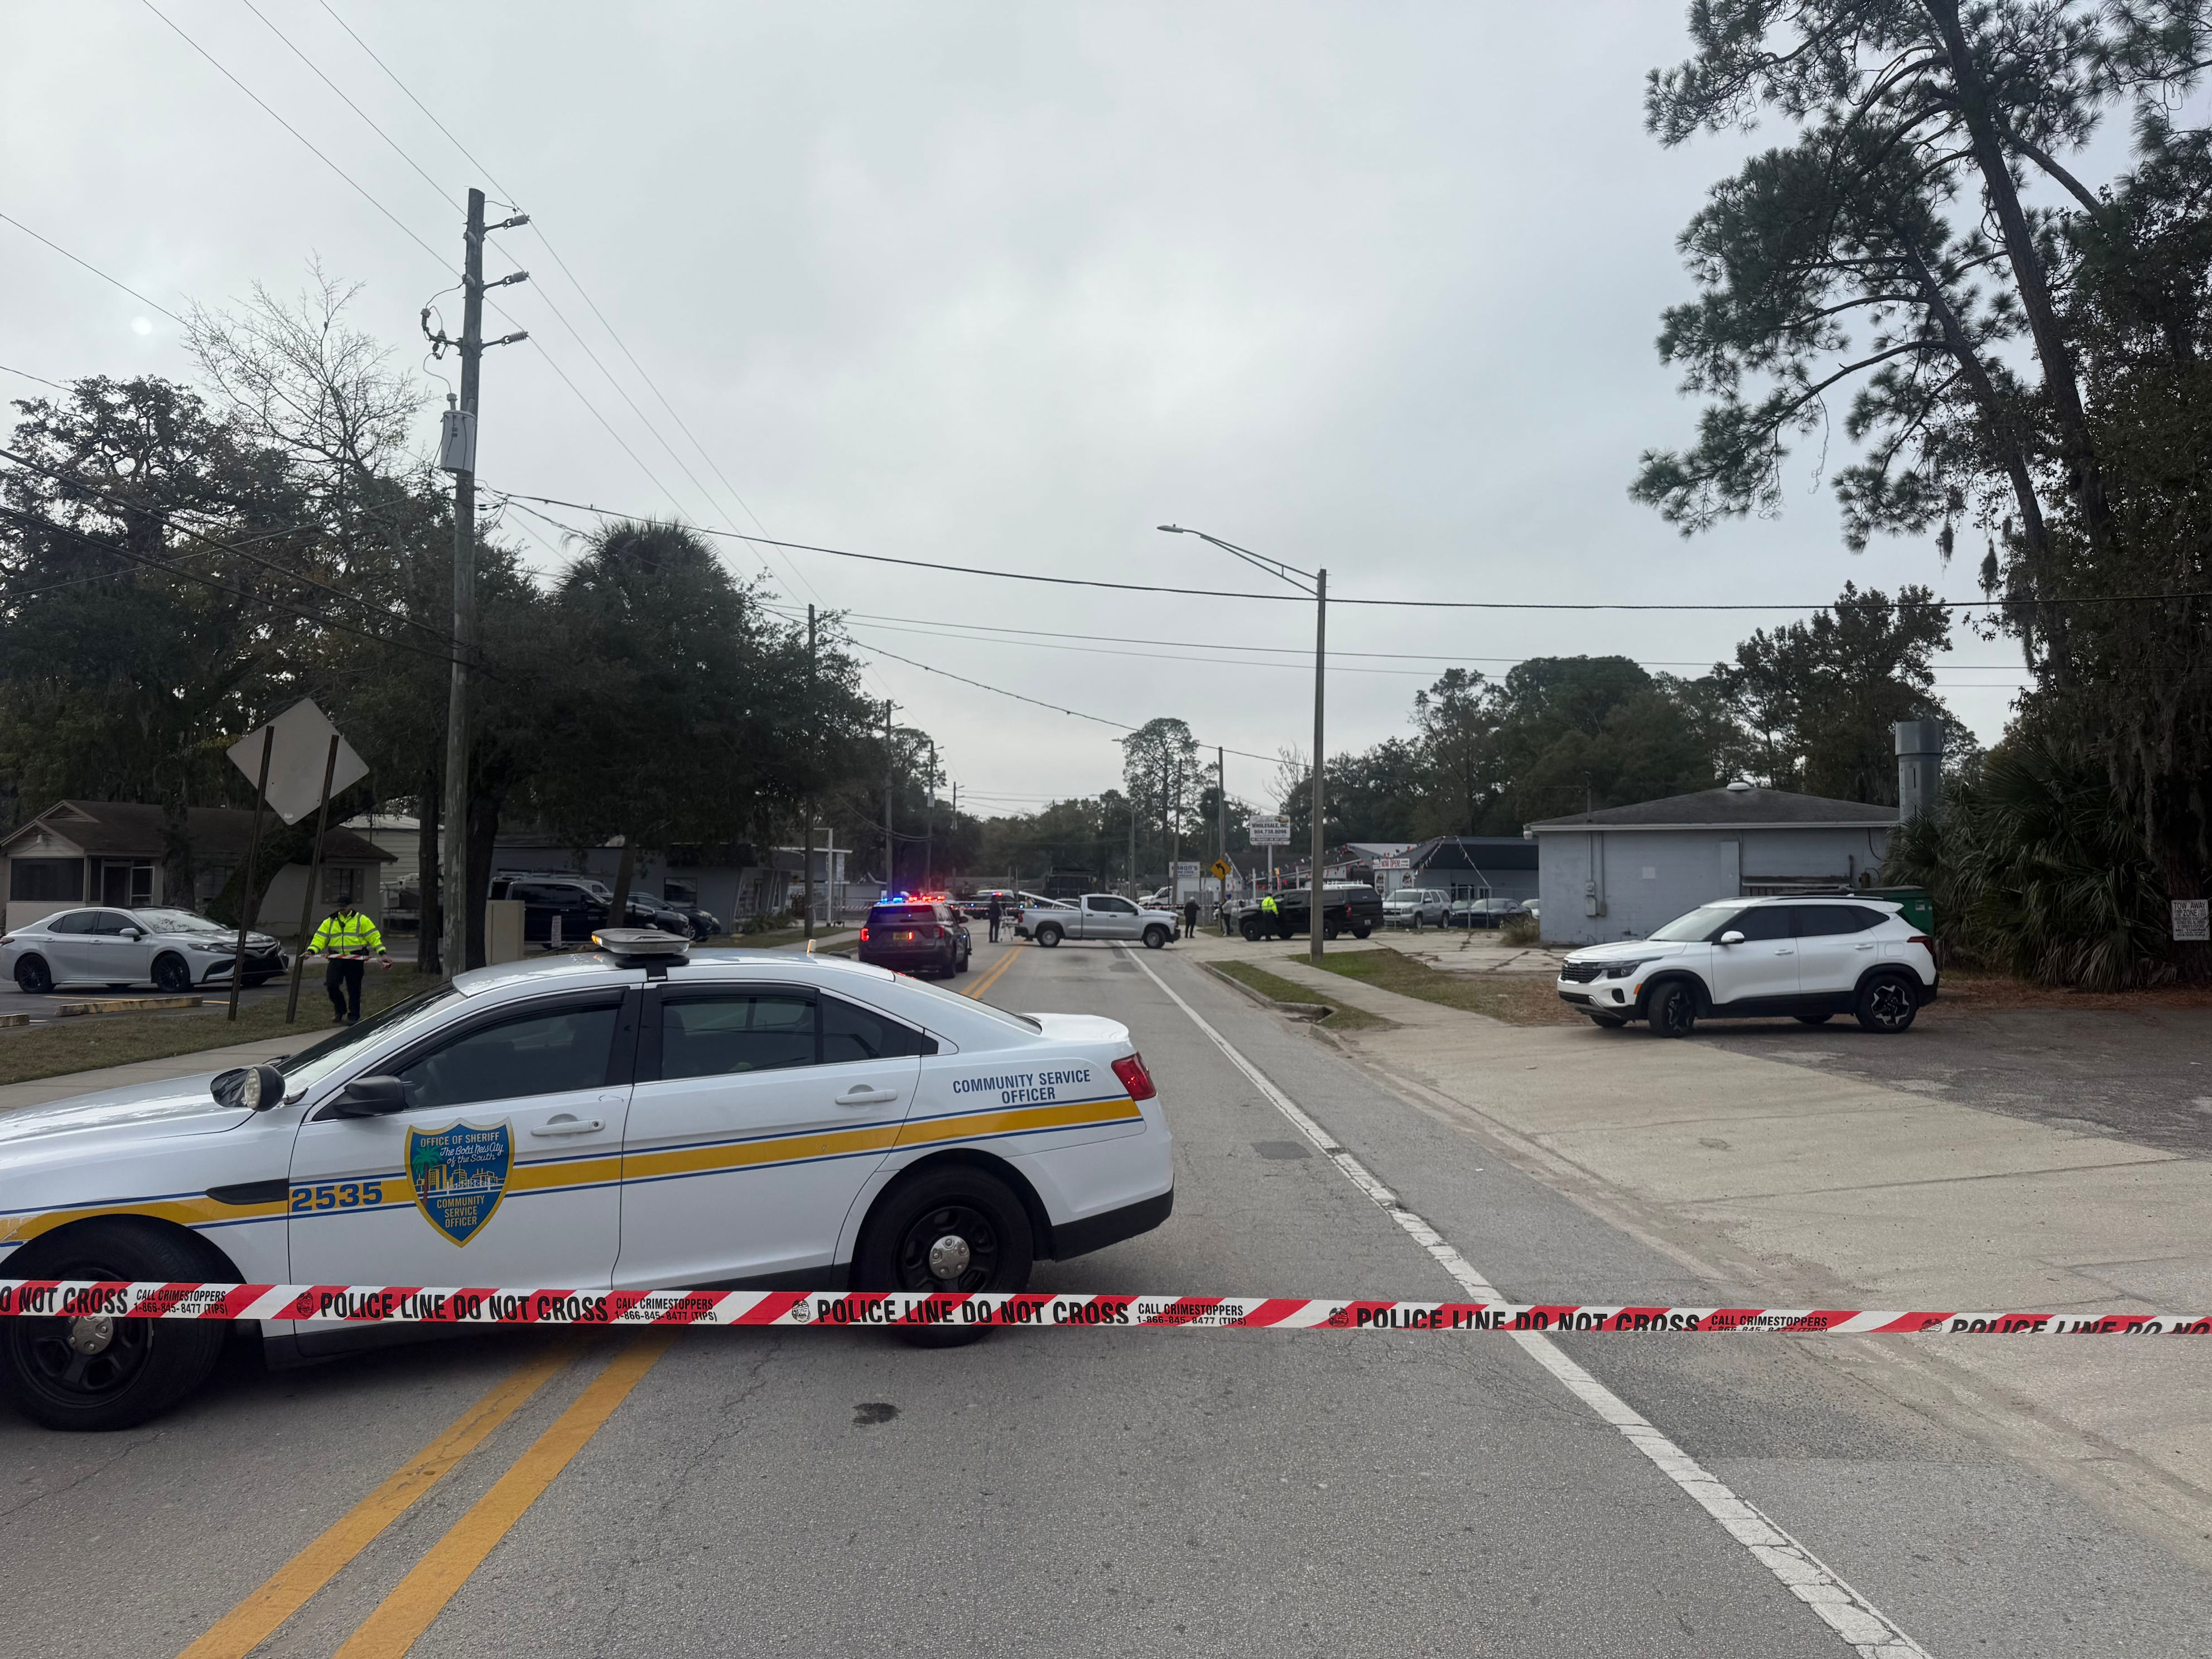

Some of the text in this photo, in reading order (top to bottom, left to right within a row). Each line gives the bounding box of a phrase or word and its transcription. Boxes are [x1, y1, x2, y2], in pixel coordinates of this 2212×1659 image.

[2190, 901, 2206, 910] AWAY
[953, 1069, 1091, 1093] COMMUNITY SERVICE
[1001, 1087, 1056, 1104] OFFICER
[421, 1132, 500, 1147] OFFICE OF SHERIFF
[440, 1141, 504, 1156] The Bold New City
[447, 1153, 495, 1167] of the South
[292, 1181, 383, 1212] 2535
[437, 1195, 485, 1209] COMMUNITY
[444, 1206, 478, 1218] SERVICE
[445, 1216, 477, 1228] OFFICER
[19, 1287, 58, 1313] NOT
[63, 1287, 128, 1314] CROSS
[136, 1289, 225, 1303] CALL CRIMESTOPPERS
[204, 1304, 228, 1315] (TIPS)
[320, 1293, 607, 1322] POLICE LINE DO NOT CROSS
[616, 1298, 713, 1310] CALL CRIMESTOPPERS
[1138, 1303, 1243, 1316] CALL CRIMESTOPPERS
[691, 1311, 717, 1322] (TIPS)
[817, 1299, 898, 1323] POLICE
[905, 1300, 955, 1323] LINE
[962, 1300, 992, 1323] DO
[1001, 1301, 1044, 1324] NOT
[1053, 1301, 1129, 1324] CROSS
[1219, 1317, 1246, 1326] (TIPS)
[1357, 1308, 1700, 1332] POLICE LINE DO NOT CROSS
[1711, 1315, 1828, 1327] CALL CRIMESTOPPERS
